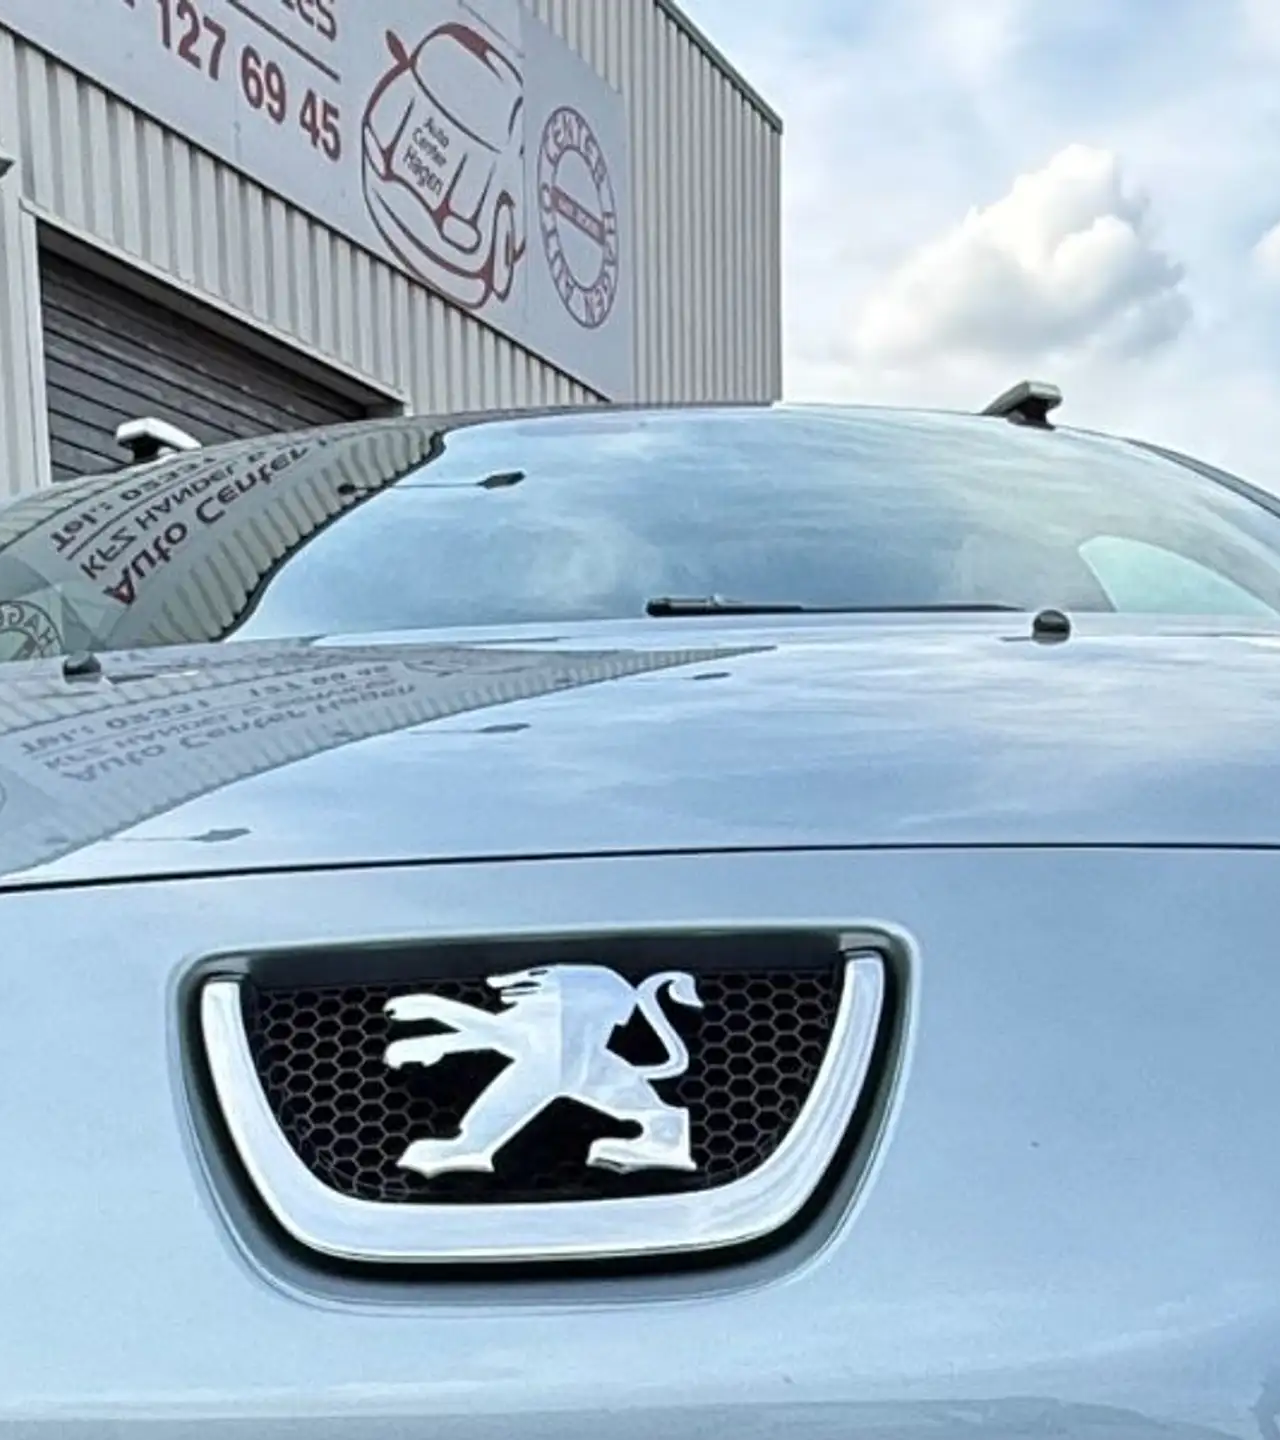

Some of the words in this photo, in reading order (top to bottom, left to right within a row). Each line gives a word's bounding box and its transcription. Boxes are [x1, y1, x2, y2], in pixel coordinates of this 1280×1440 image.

[156, 0, 227, 82] 127
[240, 44, 287, 126] 69
[299, 88, 342, 162] 45
[402, 145, 445, 196] Hagen
